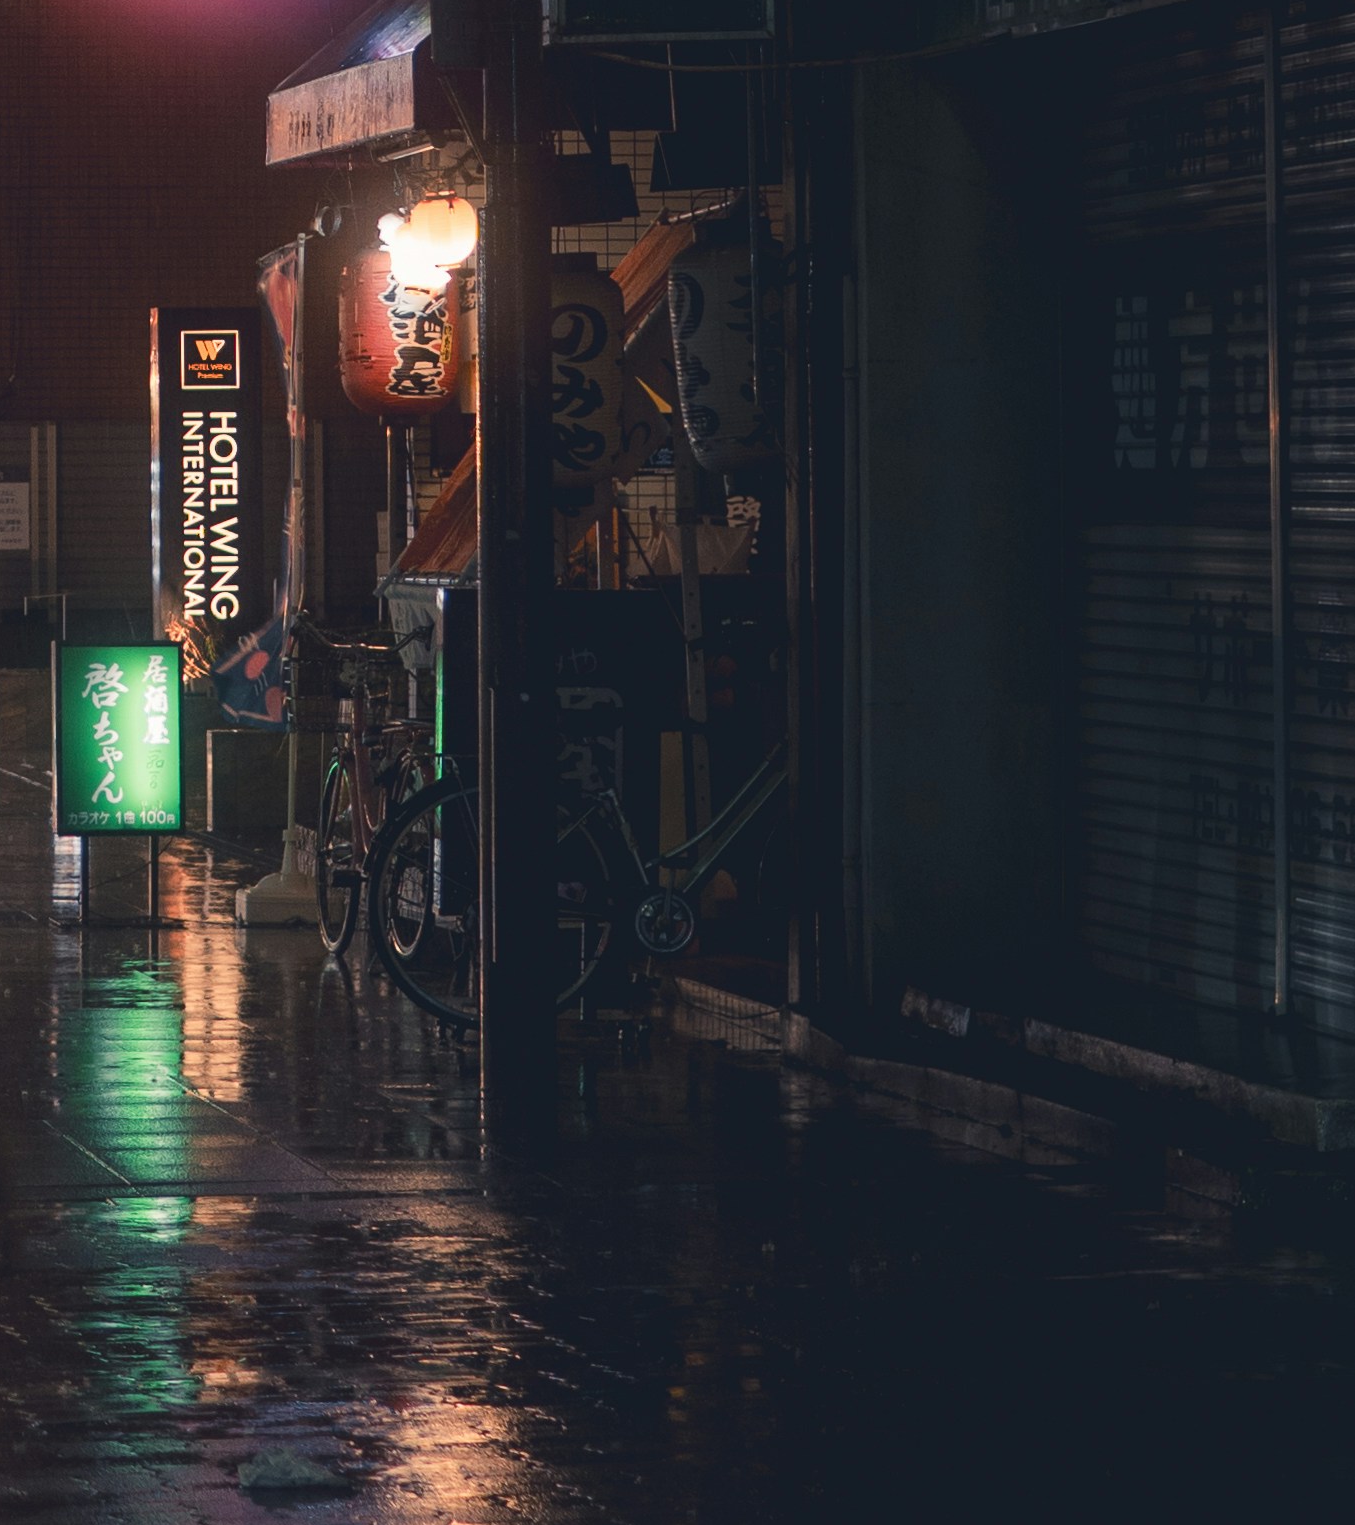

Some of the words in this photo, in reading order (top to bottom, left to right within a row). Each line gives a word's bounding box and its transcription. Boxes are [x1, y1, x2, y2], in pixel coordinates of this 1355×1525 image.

[188, 363, 210, 371] HOTEL
[210, 363, 233, 371] WING
[209, 411, 239, 512] HOTEL
[182, 411, 206, 621] INTERNATIONAL
[209, 516, 240, 620] WING
[81, 662, 129, 804] 啓ちゃん
[142, 654, 170, 745] 居酒屋
[68, 811, 110, 825] カラオケ
[140, 810, 176, 825] 100円
